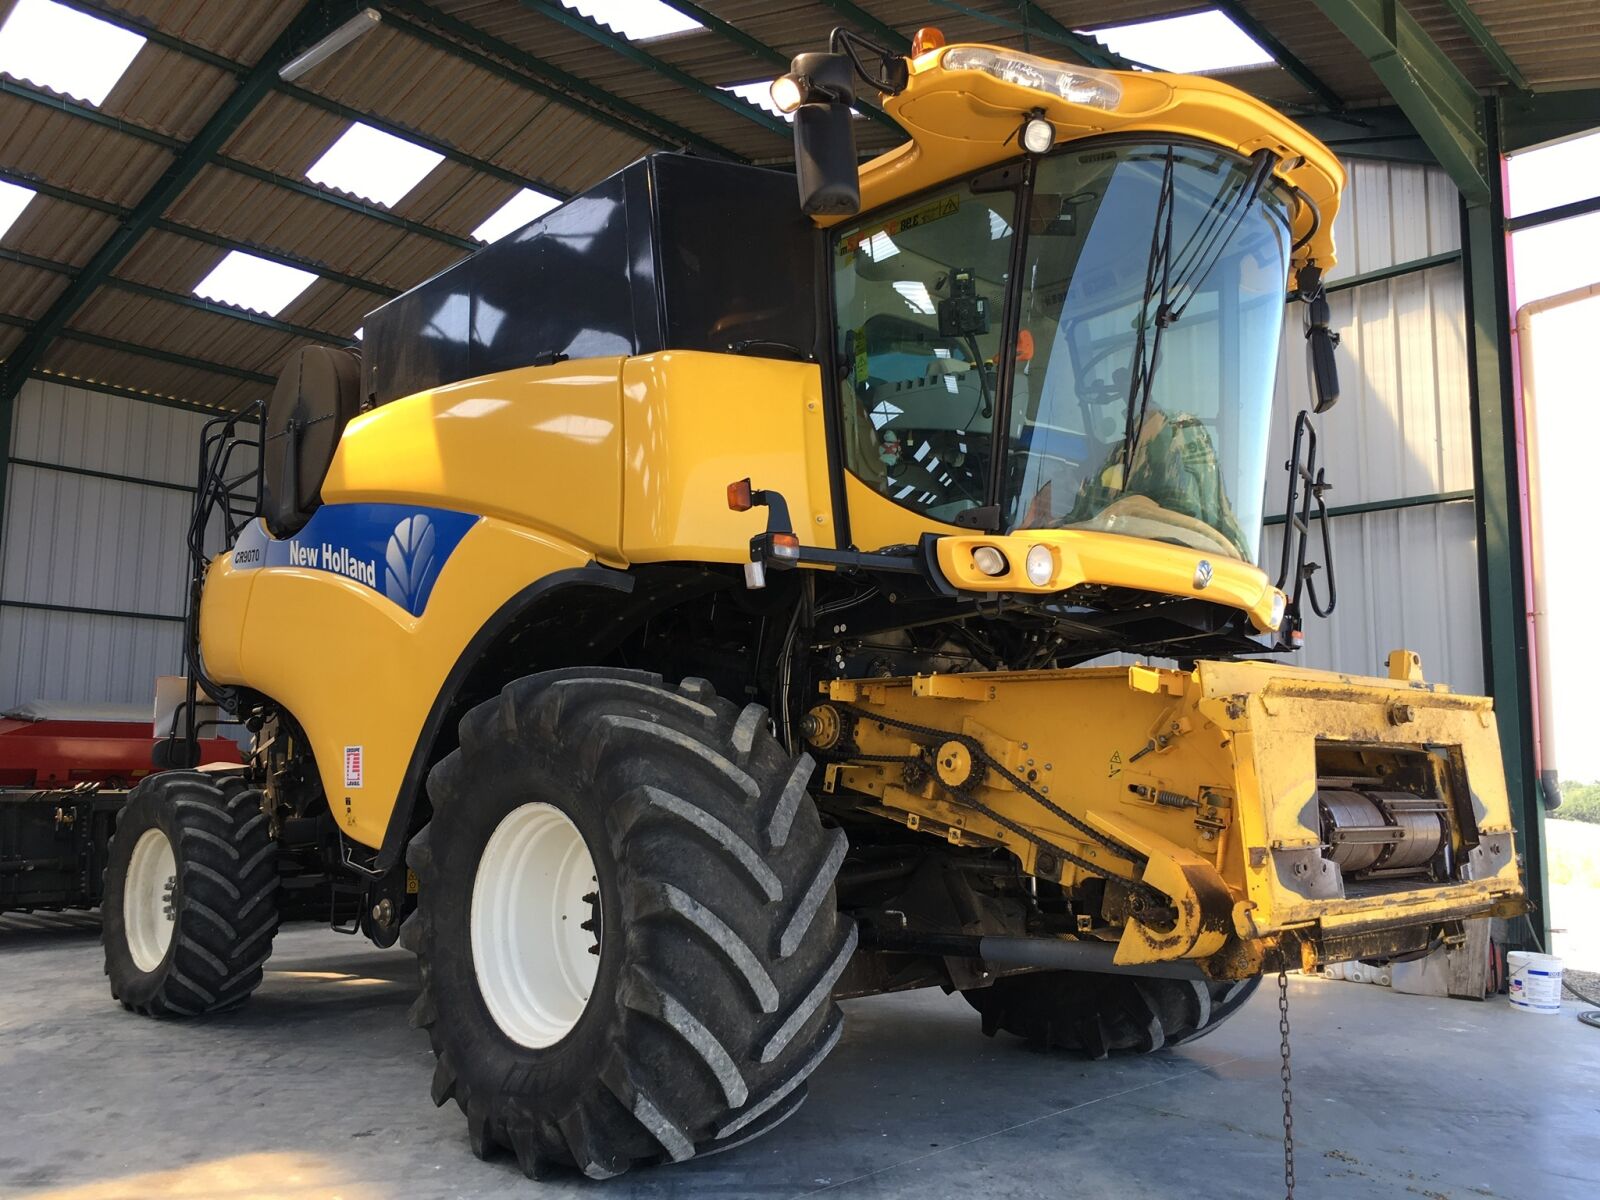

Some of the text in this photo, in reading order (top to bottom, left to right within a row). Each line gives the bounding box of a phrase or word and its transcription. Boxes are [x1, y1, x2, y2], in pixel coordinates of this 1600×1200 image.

[234, 548, 260, 564] CR9070
[289, 540, 376, 588] New Holland
